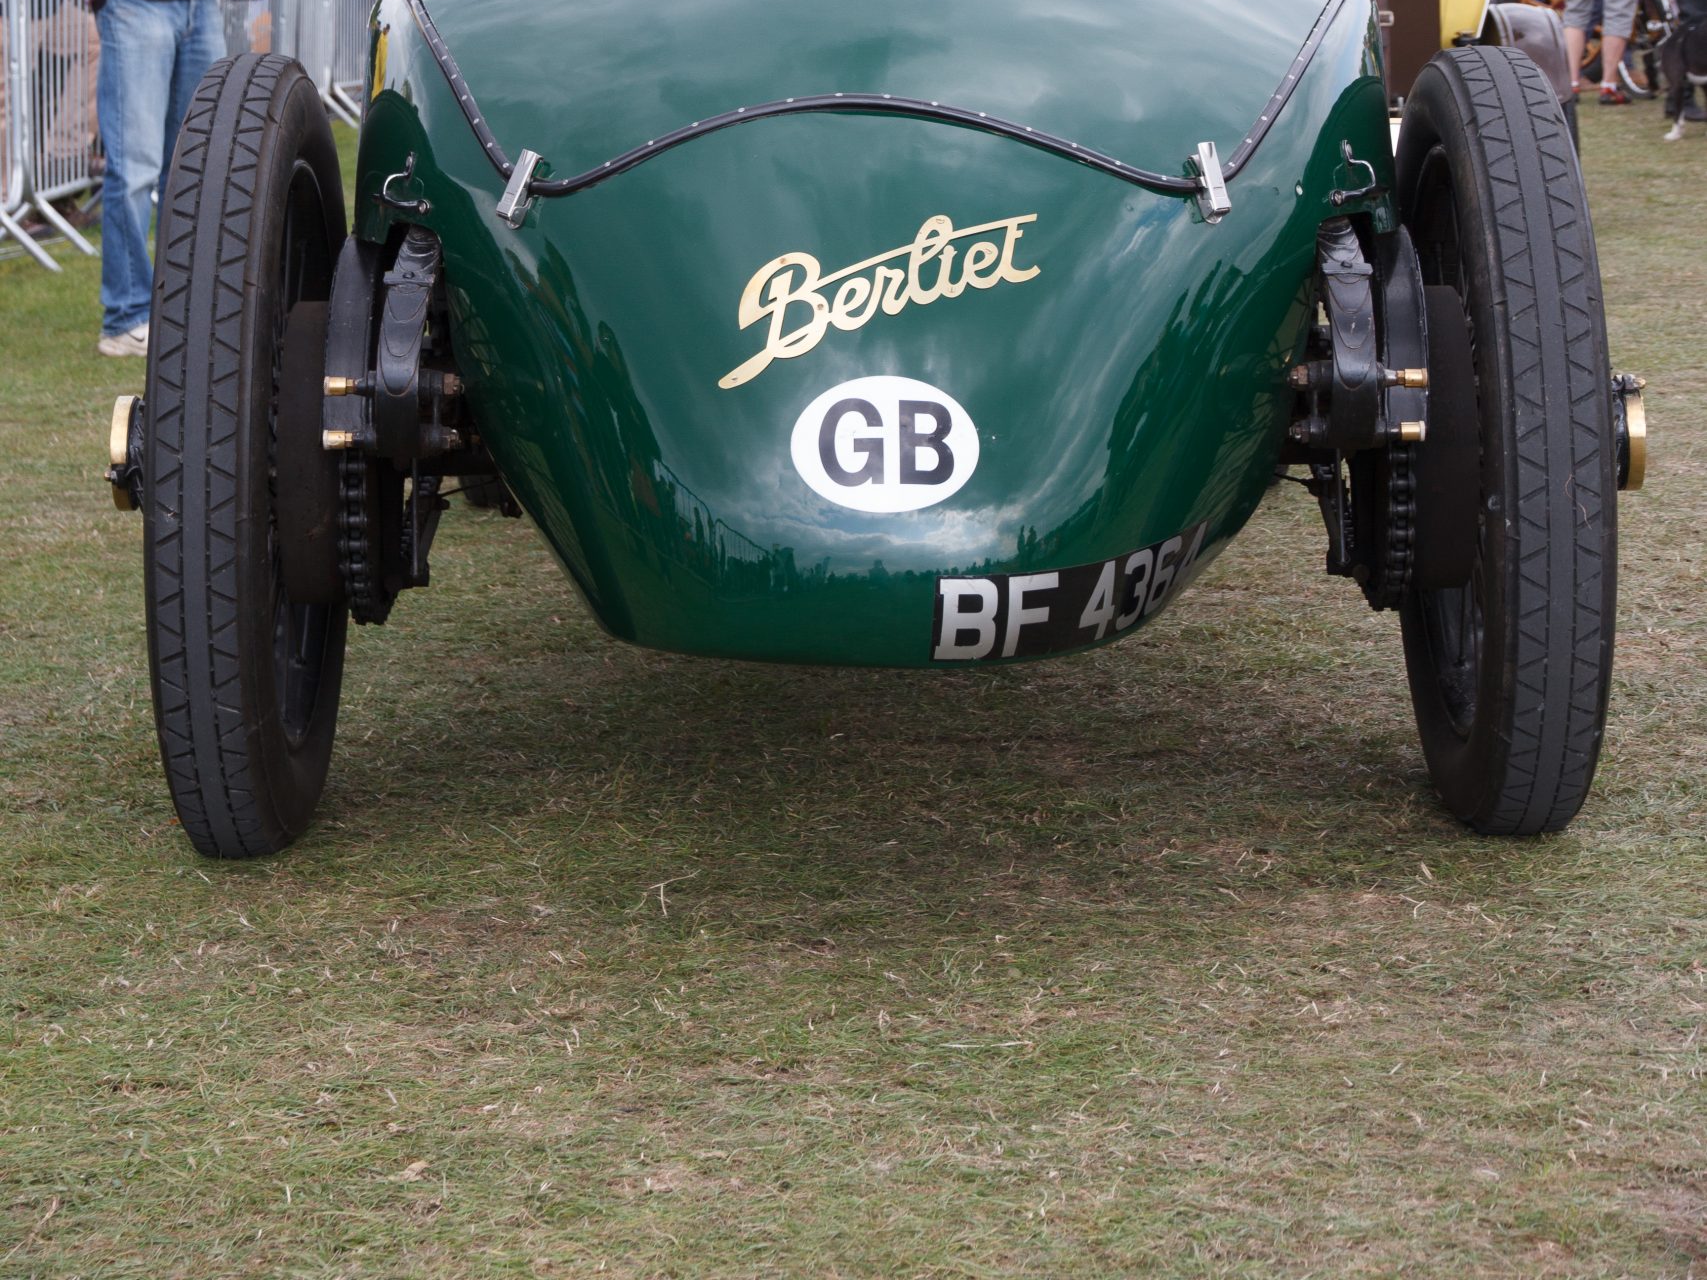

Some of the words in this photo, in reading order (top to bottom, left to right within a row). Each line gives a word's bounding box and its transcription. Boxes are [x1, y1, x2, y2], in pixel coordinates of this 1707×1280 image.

[718, 214, 1041, 389] Berliet
[818, 397, 955, 487] GB
[933, 571, 1059, 660] BF
